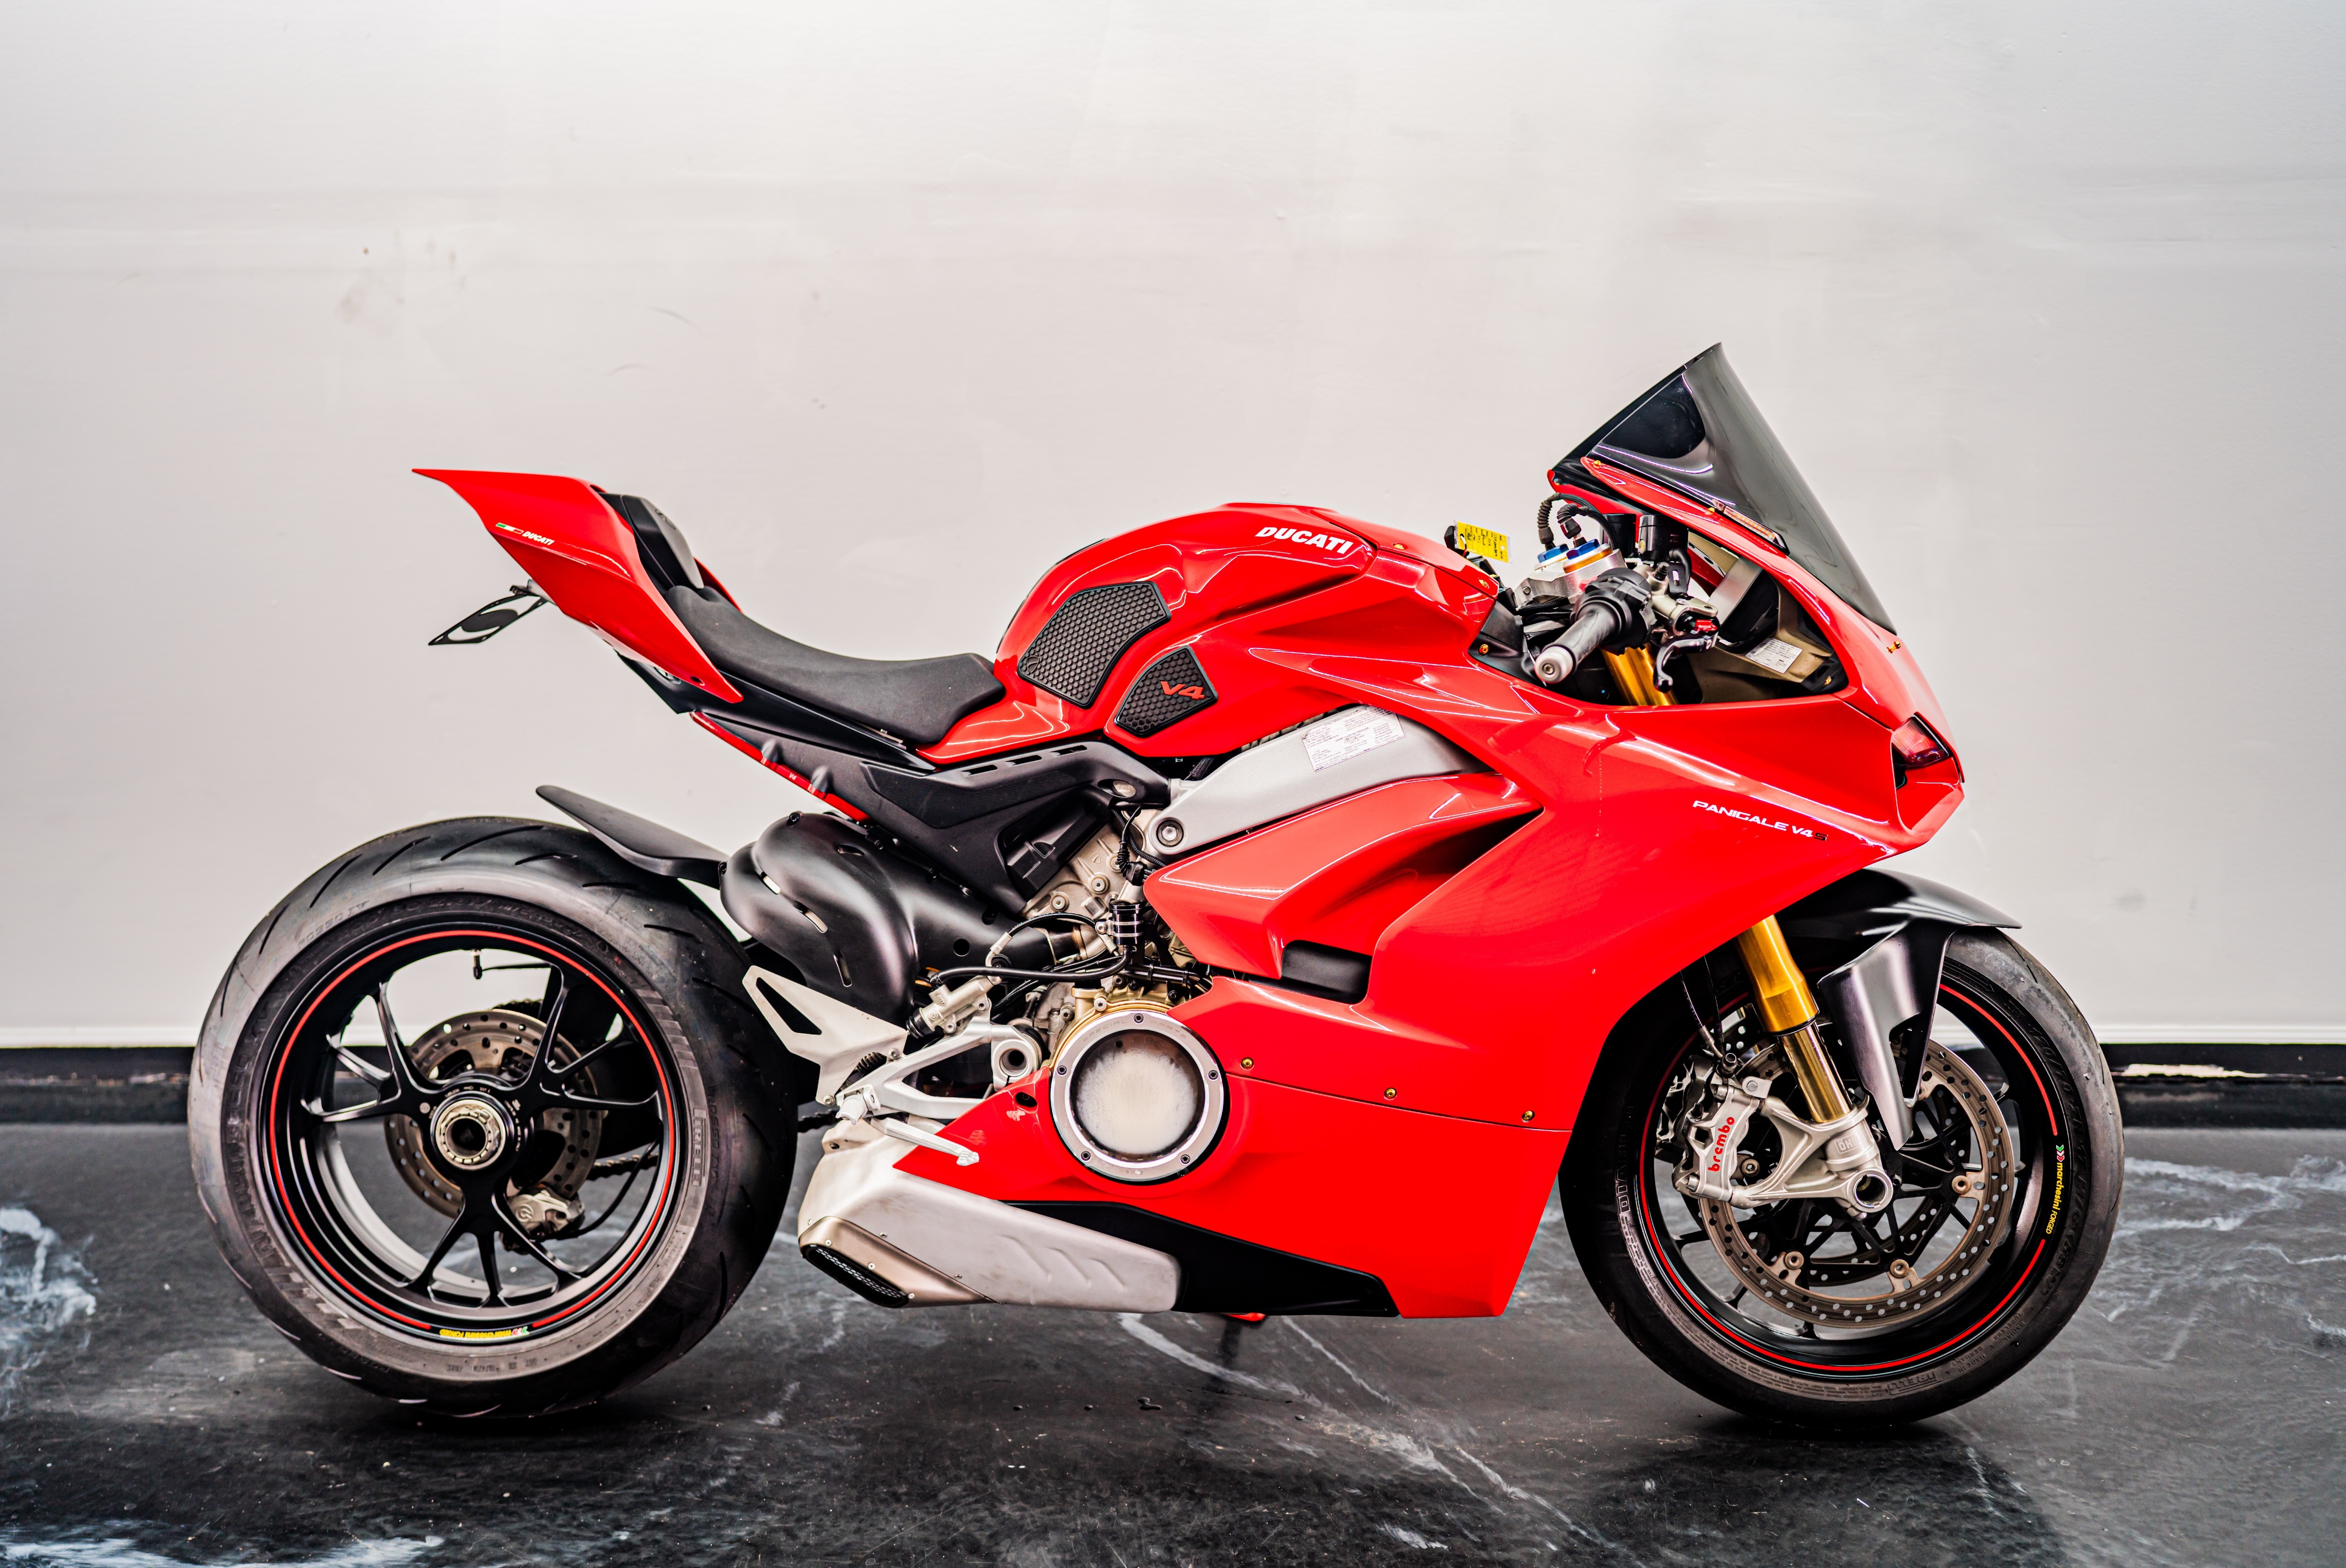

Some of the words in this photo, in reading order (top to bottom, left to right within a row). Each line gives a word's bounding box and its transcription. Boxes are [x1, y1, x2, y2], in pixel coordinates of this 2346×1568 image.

[522, 531, 555, 546] DUCATI
[1255, 527, 1354, 554] DUCATI
[1160, 681, 1205, 700] V4
[1692, 800, 1789, 831] PANIGALE
[1791, 825, 1813, 838] V4
[1814, 832, 1828, 841] S
[1082, 1020, 1128, 1043] SPECIAL
[1150, 1020, 1188, 1039] PARTS
[2028, 1025, 2074, 1096] 120/70
[689, 1106, 709, 1188] PIRELLI
[1708, 1117, 1735, 1172] brembo
[2052, 1161, 2065, 1210] marchesini
[2046, 1210, 2057, 1234] FORGED
[465, 1329, 512, 1339] marchesini
[1991, 1312, 2023, 1341] TUBELESS
[2002, 1319, 2026, 1343] RADIAL
[1951, 1345, 1983, 1367] GERMANY
[1966, 1353, 1986, 1368] MADE
[1887, 1368, 1944, 1396] PIRELLI
